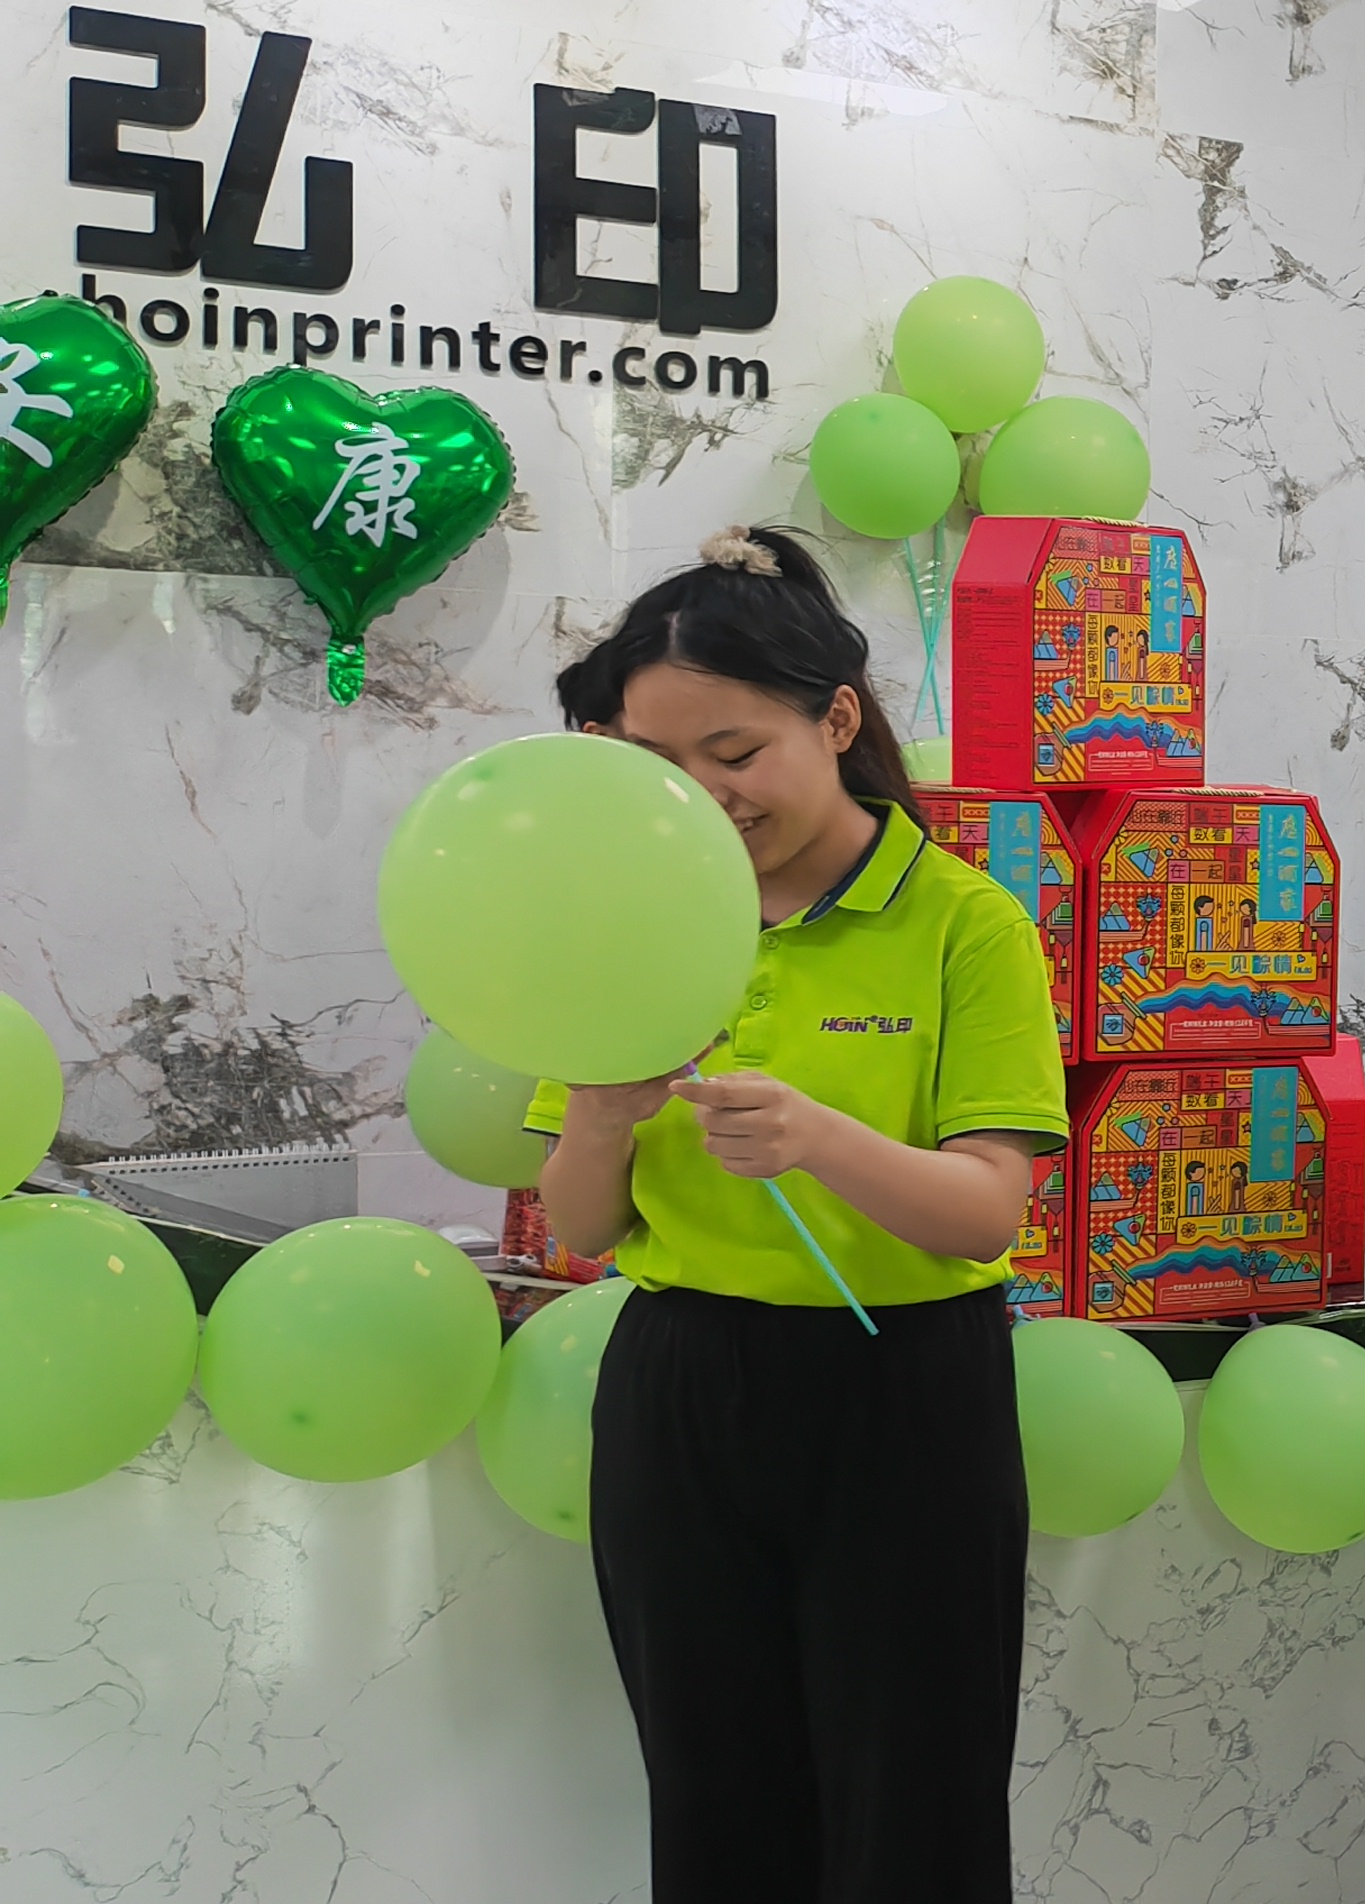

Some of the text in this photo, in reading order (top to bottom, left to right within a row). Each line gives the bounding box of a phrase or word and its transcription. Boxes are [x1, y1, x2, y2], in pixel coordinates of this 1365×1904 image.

[312, 422, 420, 548] 康
[1194, 828, 1226, 841] 数看
[1169, 863, 1223, 879] 在 一起
[1169, 885, 1186, 965] 每颗都像你
[878, 1016, 913, 1034] 弘印
[1186, 1094, 1219, 1107] 数看
[1162, 1129, 1215, 1146] 在 一起
[1160, 1152, 1176, 1231] 每颗都像你
